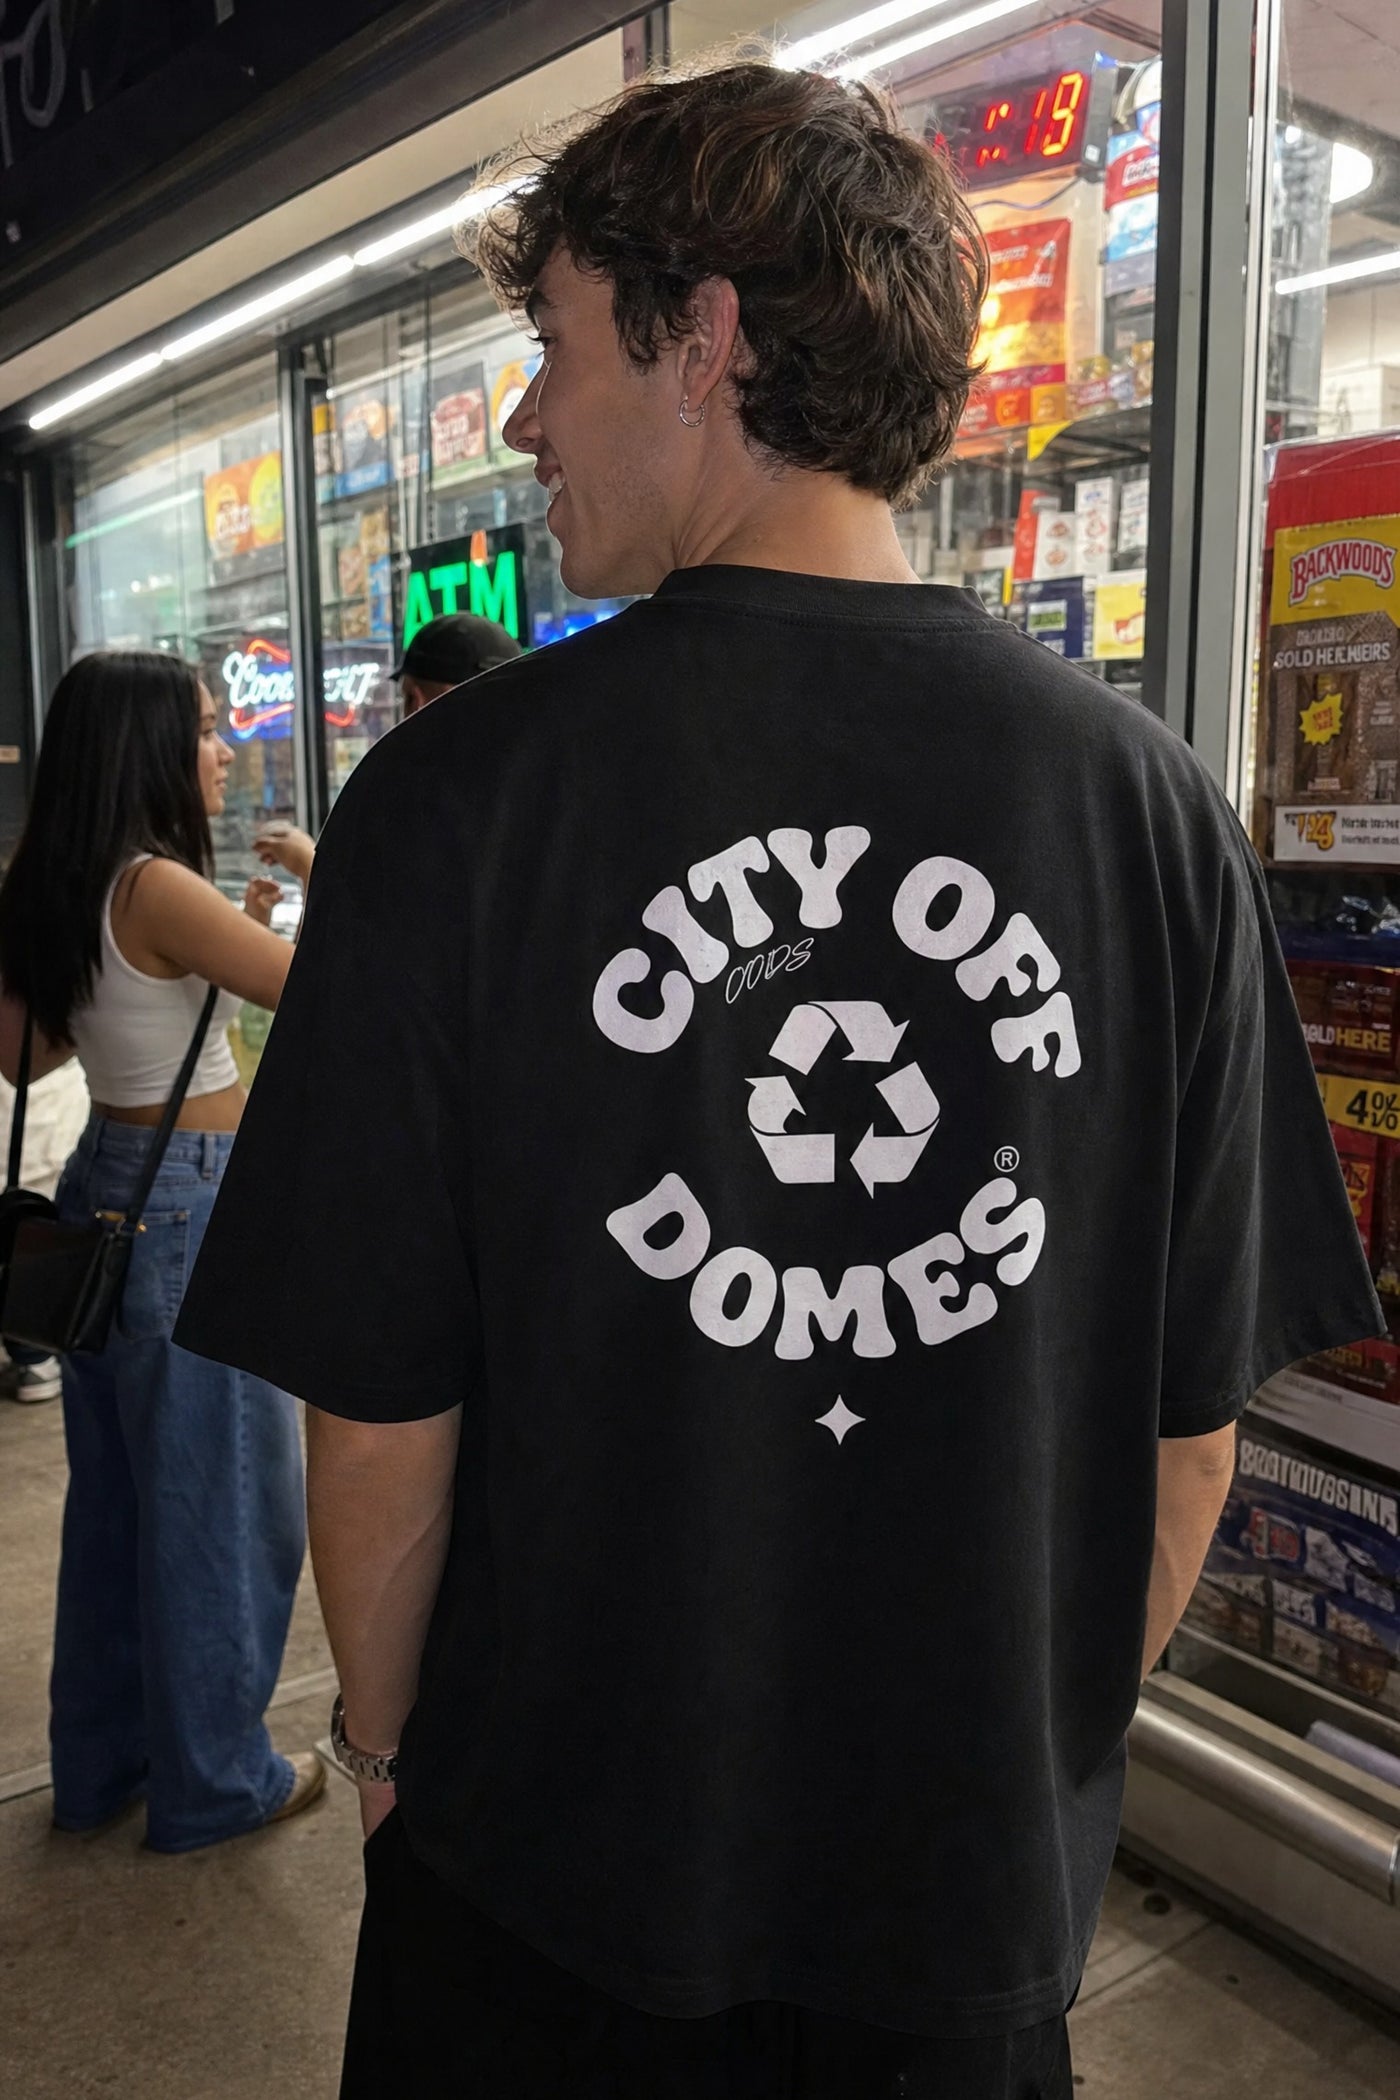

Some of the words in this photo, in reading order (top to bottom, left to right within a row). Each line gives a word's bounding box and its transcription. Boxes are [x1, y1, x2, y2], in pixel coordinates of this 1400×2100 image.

[403, 551, 519, 651] ATM
[1289, 540, 1396, 606] BACKWOODS
[593, 826, 870, 1053] CITY
[893, 856, 1081, 1078] OFF
[1336, 1027, 1392, 1053] HERE
[606, 1173, 1045, 1360] DOMES
